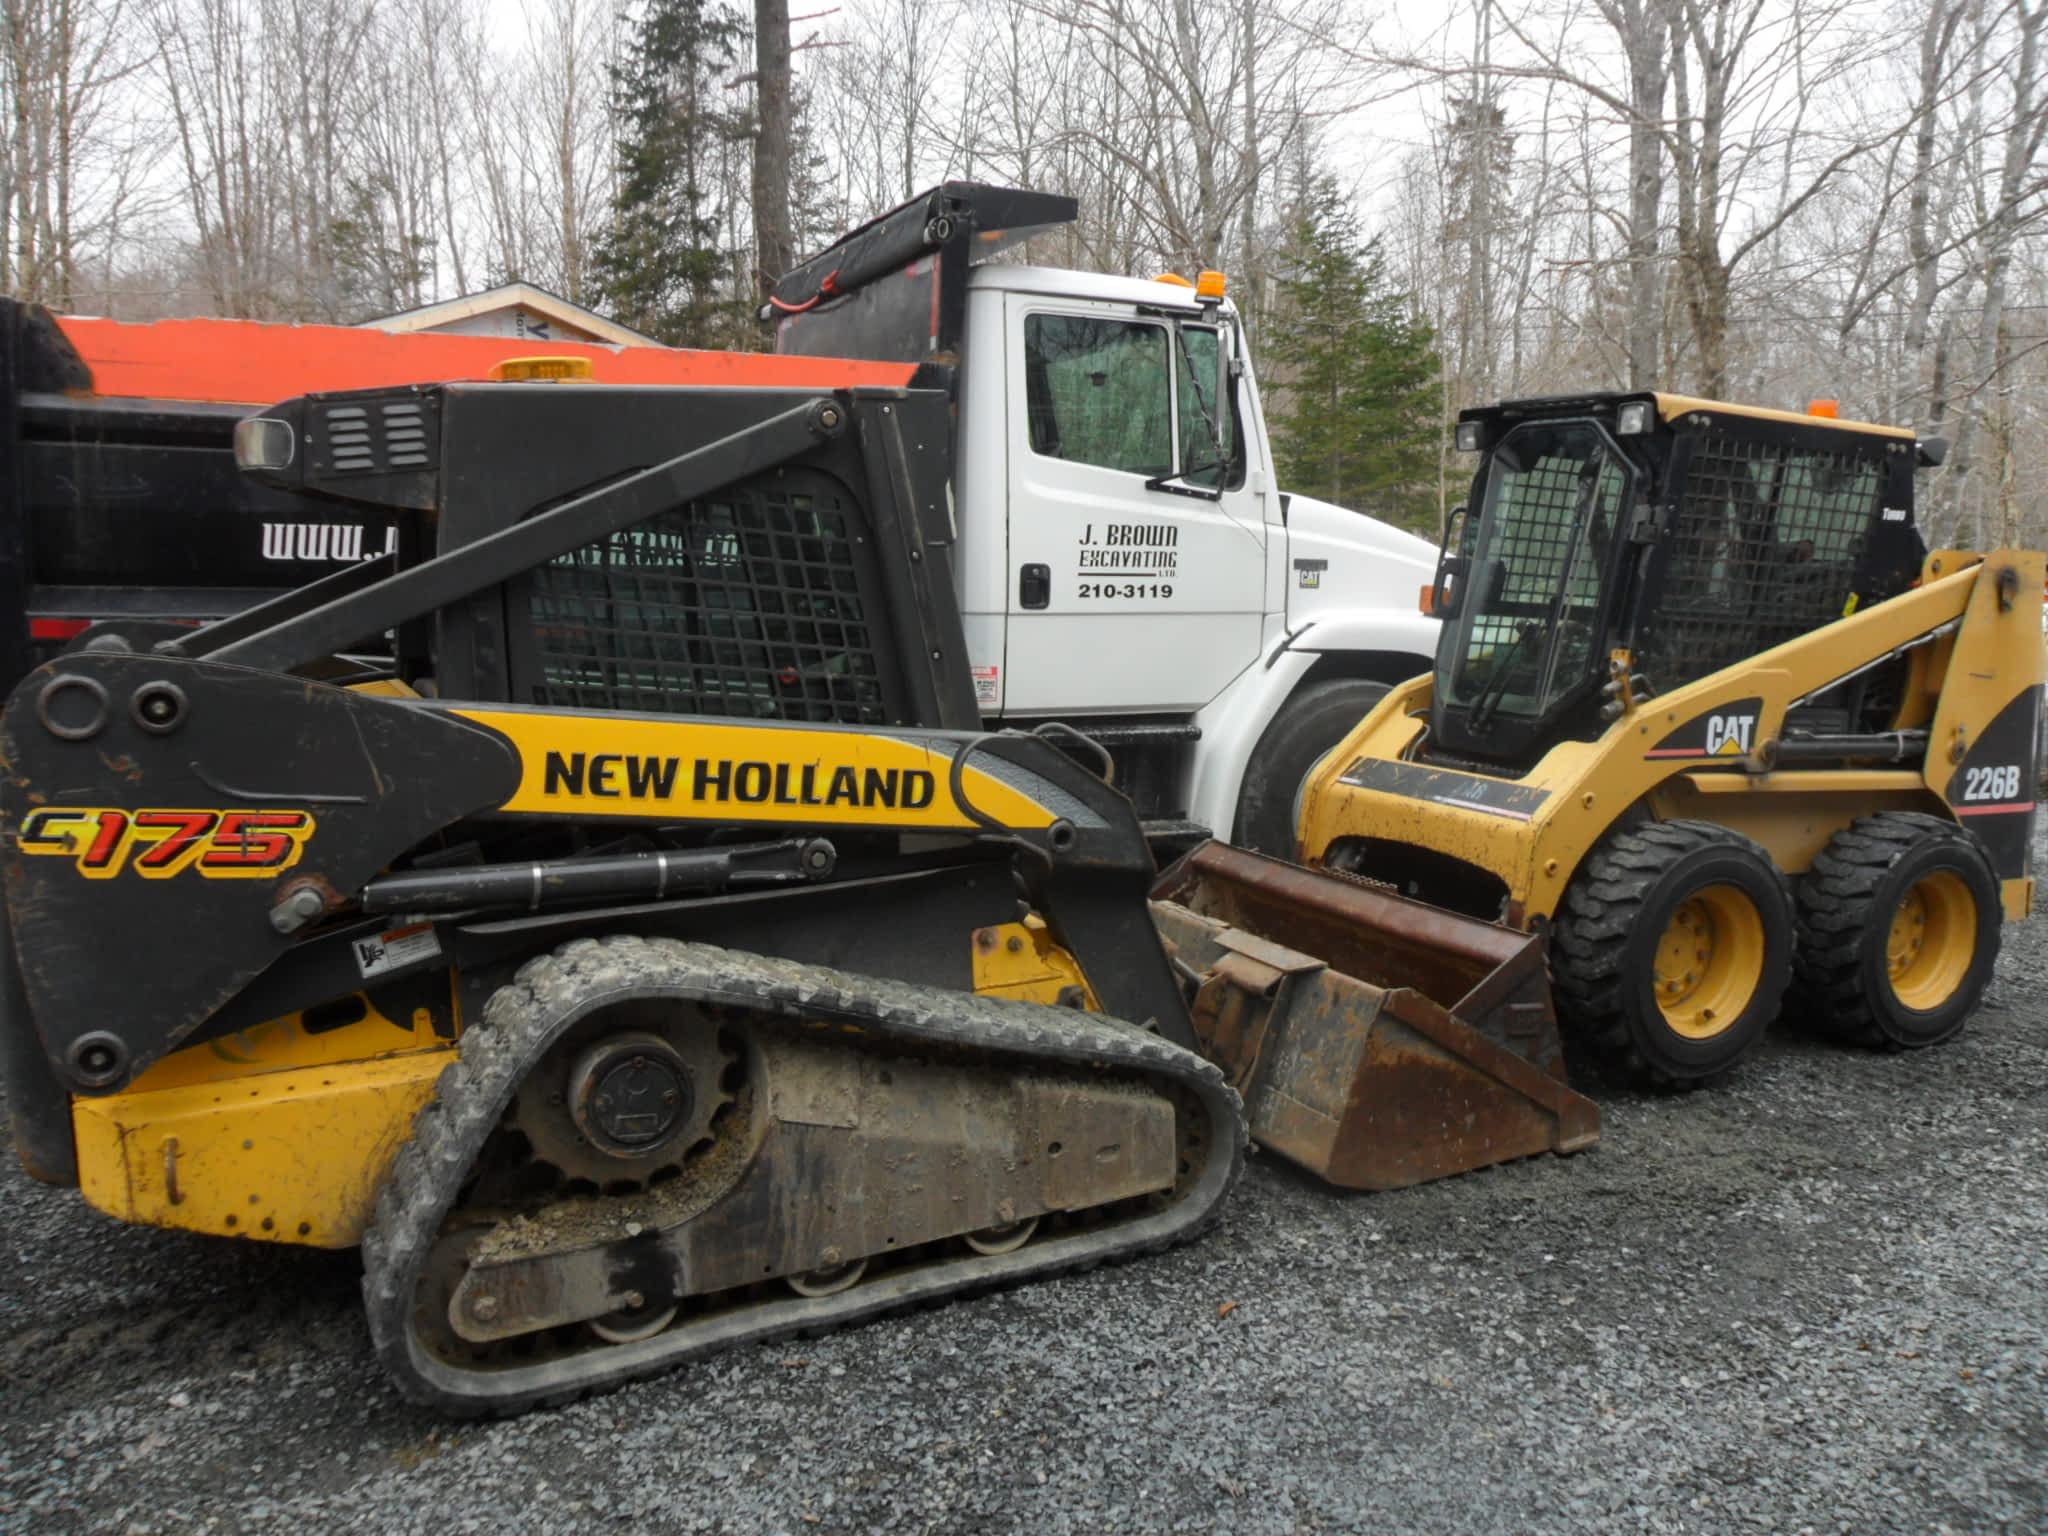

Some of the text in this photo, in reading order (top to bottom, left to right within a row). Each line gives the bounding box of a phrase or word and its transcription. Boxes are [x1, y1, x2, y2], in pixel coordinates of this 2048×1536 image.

[1079, 524, 1178, 546] J. BROWN
[1079, 550, 1178, 568] EXCAVATING
[1078, 584, 1173, 598] 210-3119
[1706, 715, 1754, 756] CAT
[544, 751, 936, 809] NEW HOLLAND
[1964, 766, 2021, 800] 226B
